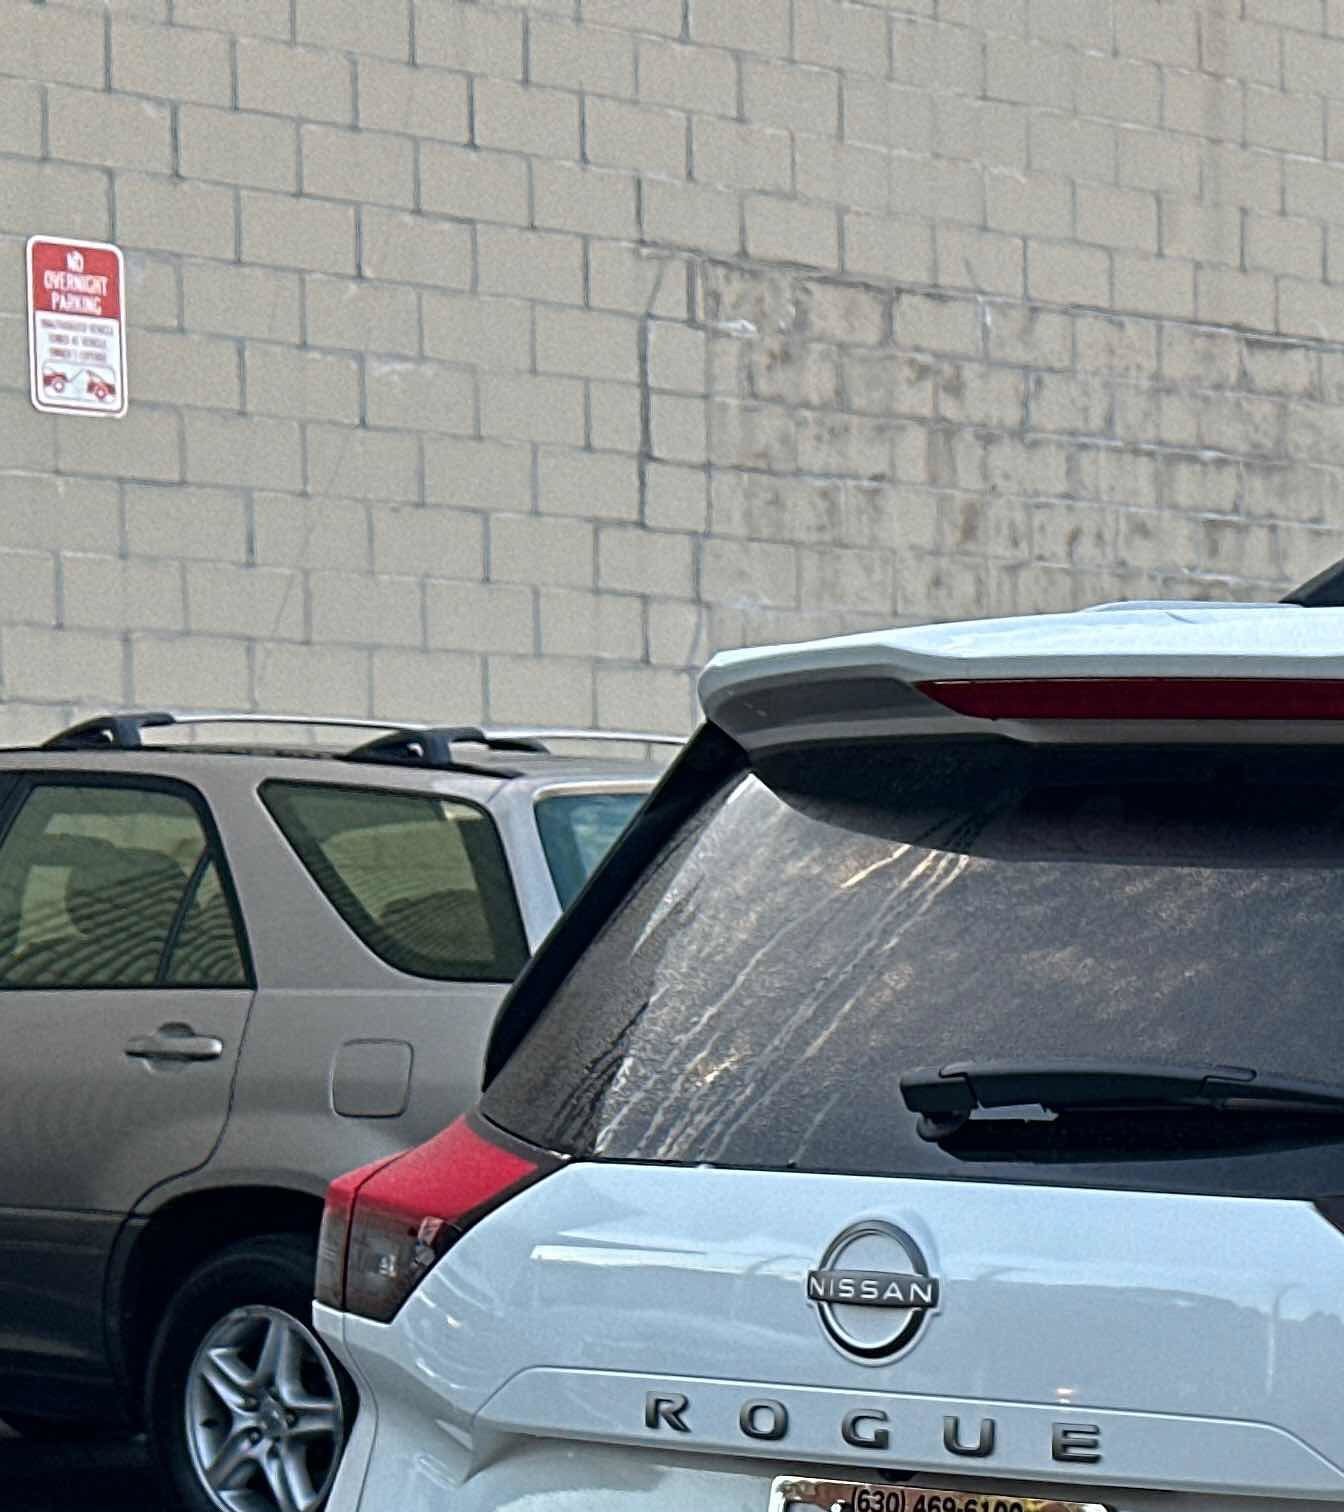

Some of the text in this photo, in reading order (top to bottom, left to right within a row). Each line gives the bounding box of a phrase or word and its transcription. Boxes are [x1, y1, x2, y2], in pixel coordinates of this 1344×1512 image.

[66, 250, 85, 273] NO
[43, 269, 109, 297] OVERNIGHT
[51, 290, 102, 316] PARKING
[809, 1276, 934, 1305] NISSAN
[644, 1390, 1103, 1464] ROGUE
